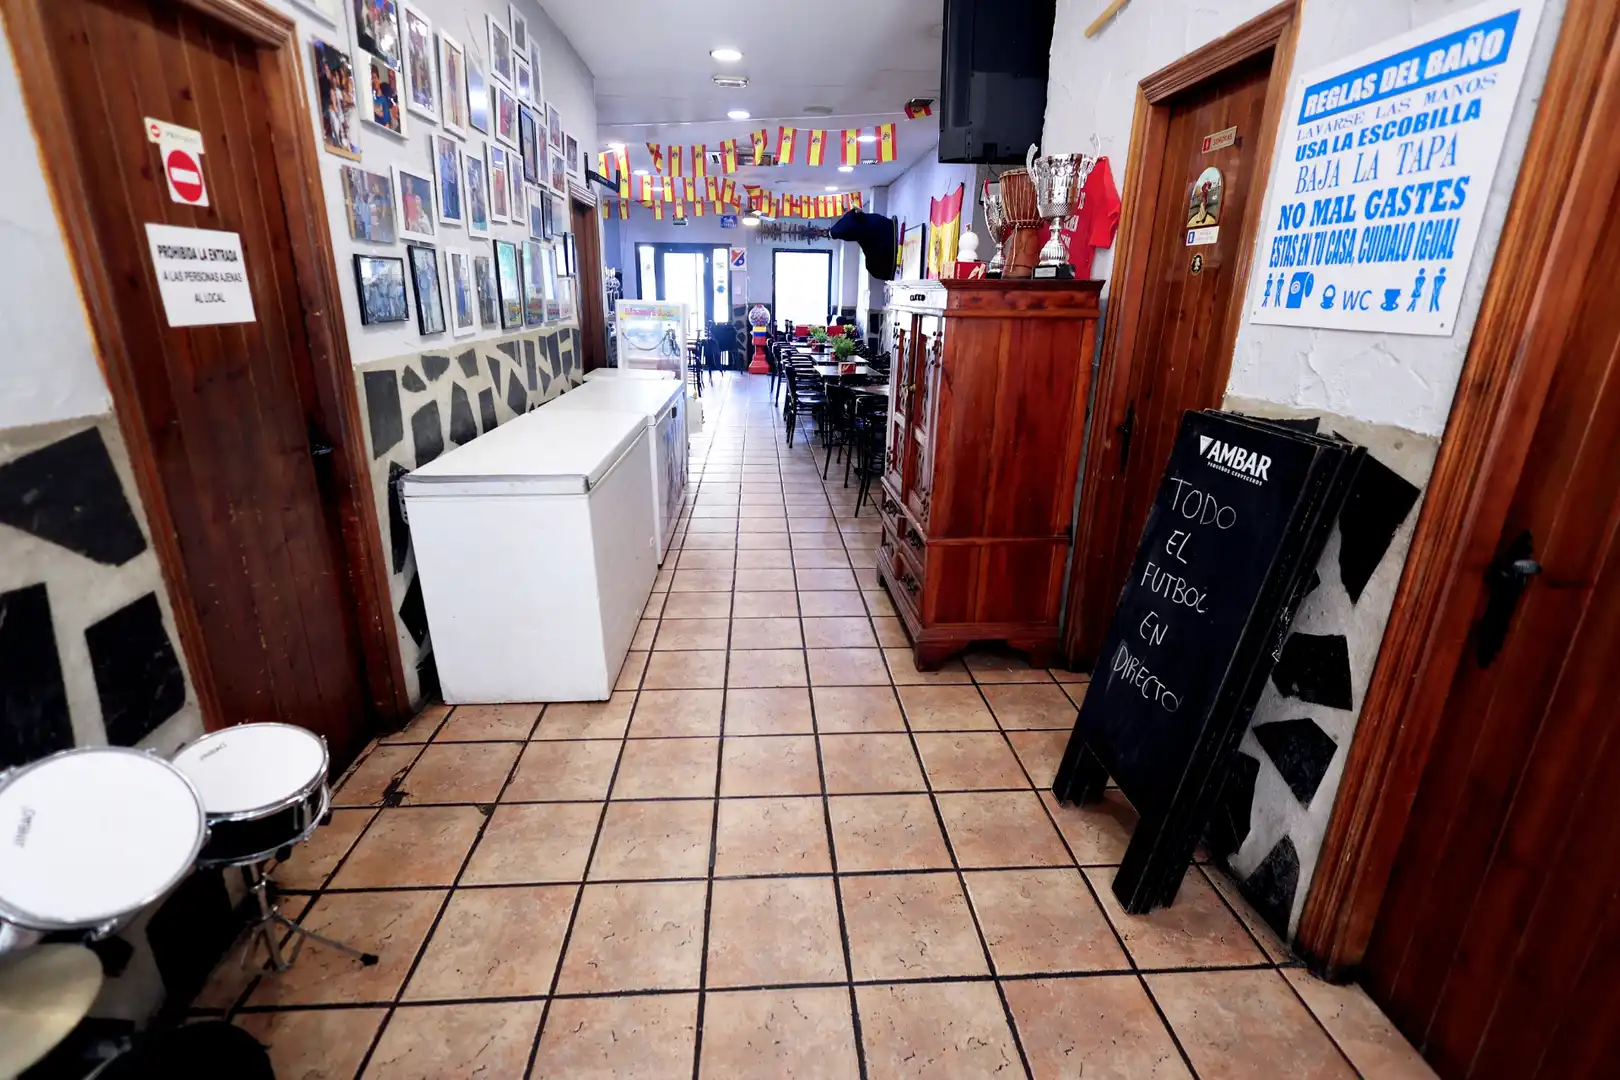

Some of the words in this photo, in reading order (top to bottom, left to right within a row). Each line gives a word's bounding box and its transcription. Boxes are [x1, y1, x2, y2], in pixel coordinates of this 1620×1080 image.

[1304, 72, 1378, 119] REGLAS
[1379, 57, 1421, 94] DEL
[1423, 27, 1506, 80] BAÑO
[1295, 138, 1328, 162] USA
[1332, 132, 1354, 153] LA
[1357, 98, 1482, 147] ESCOBILLA
[1296, 111, 1365, 142] LAVARSE
[1375, 98, 1411, 120] LAS
[1424, 71, 1499, 106] MANOS
[1295, 158, 1341, 194] BAJA
[1352, 149, 1379, 183] LA
[1397, 131, 1458, 176] TAPA
[1277, 202, 1307, 231] NO
[1309, 194, 1357, 228] MAL
[1364, 175, 1471, 220] GASTES
[157, 244, 198, 260] PROHIBIDA
[198, 248, 208, 261] LA
[208, 248, 238, 262] ENTRADA
[1269, 234, 1299, 268] ESTAS
[1296, 232, 1314, 266] EN
[1310, 230, 1329, 265] TU
[1324, 227, 1359, 267] CASA,
[1357, 221, 1417, 264] CUIDALO
[1412, 217, 1462, 260] IGUAL
[163, 270, 170, 280] A
[170, 271, 184, 282] LAS
[184, 271, 220, 283] PERSONAS
[220, 272, 244, 283] AJENAS
[194, 293, 204, 303] AL
[203, 292, 227, 303] LOCAL
[1342, 290, 1373, 311] WC
[1206, 440, 1272, 481] AMBAR
[1170, 477, 1237, 530] TODO
[1166, 530, 1192, 565] EL
[1141, 561, 1207, 614] FUTBOL
[1140, 611, 1169, 646] EN
[1113, 645, 1179, 712] DIRECTO
